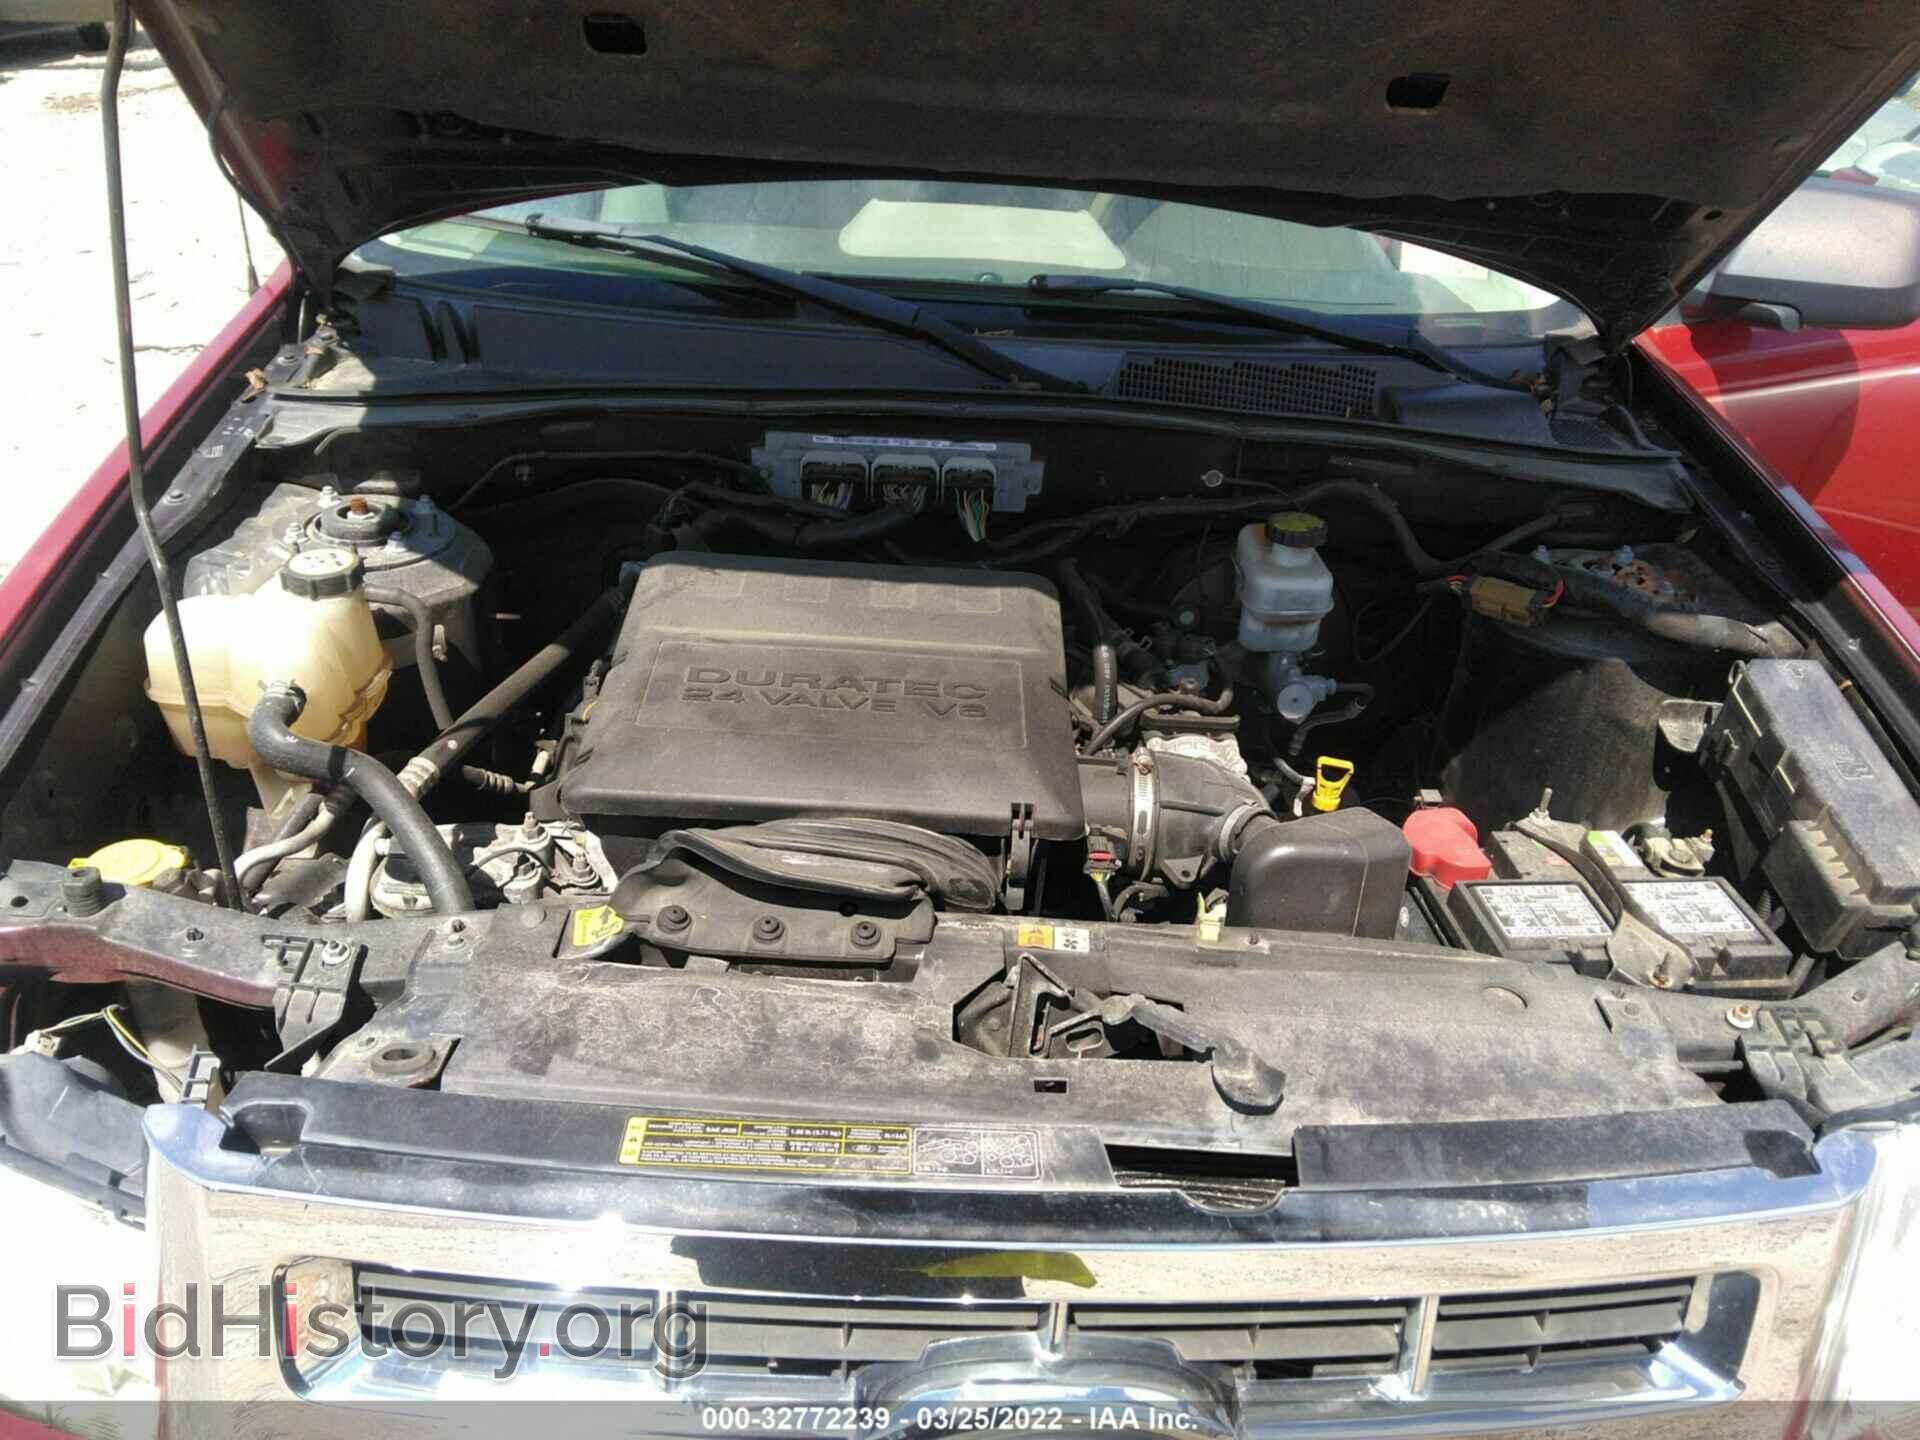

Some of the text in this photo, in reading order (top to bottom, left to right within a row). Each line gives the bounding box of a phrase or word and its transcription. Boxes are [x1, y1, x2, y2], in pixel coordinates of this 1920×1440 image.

[685, 666, 987, 700] DURATEC
[681, 687, 987, 718] 24 VALVE V6
